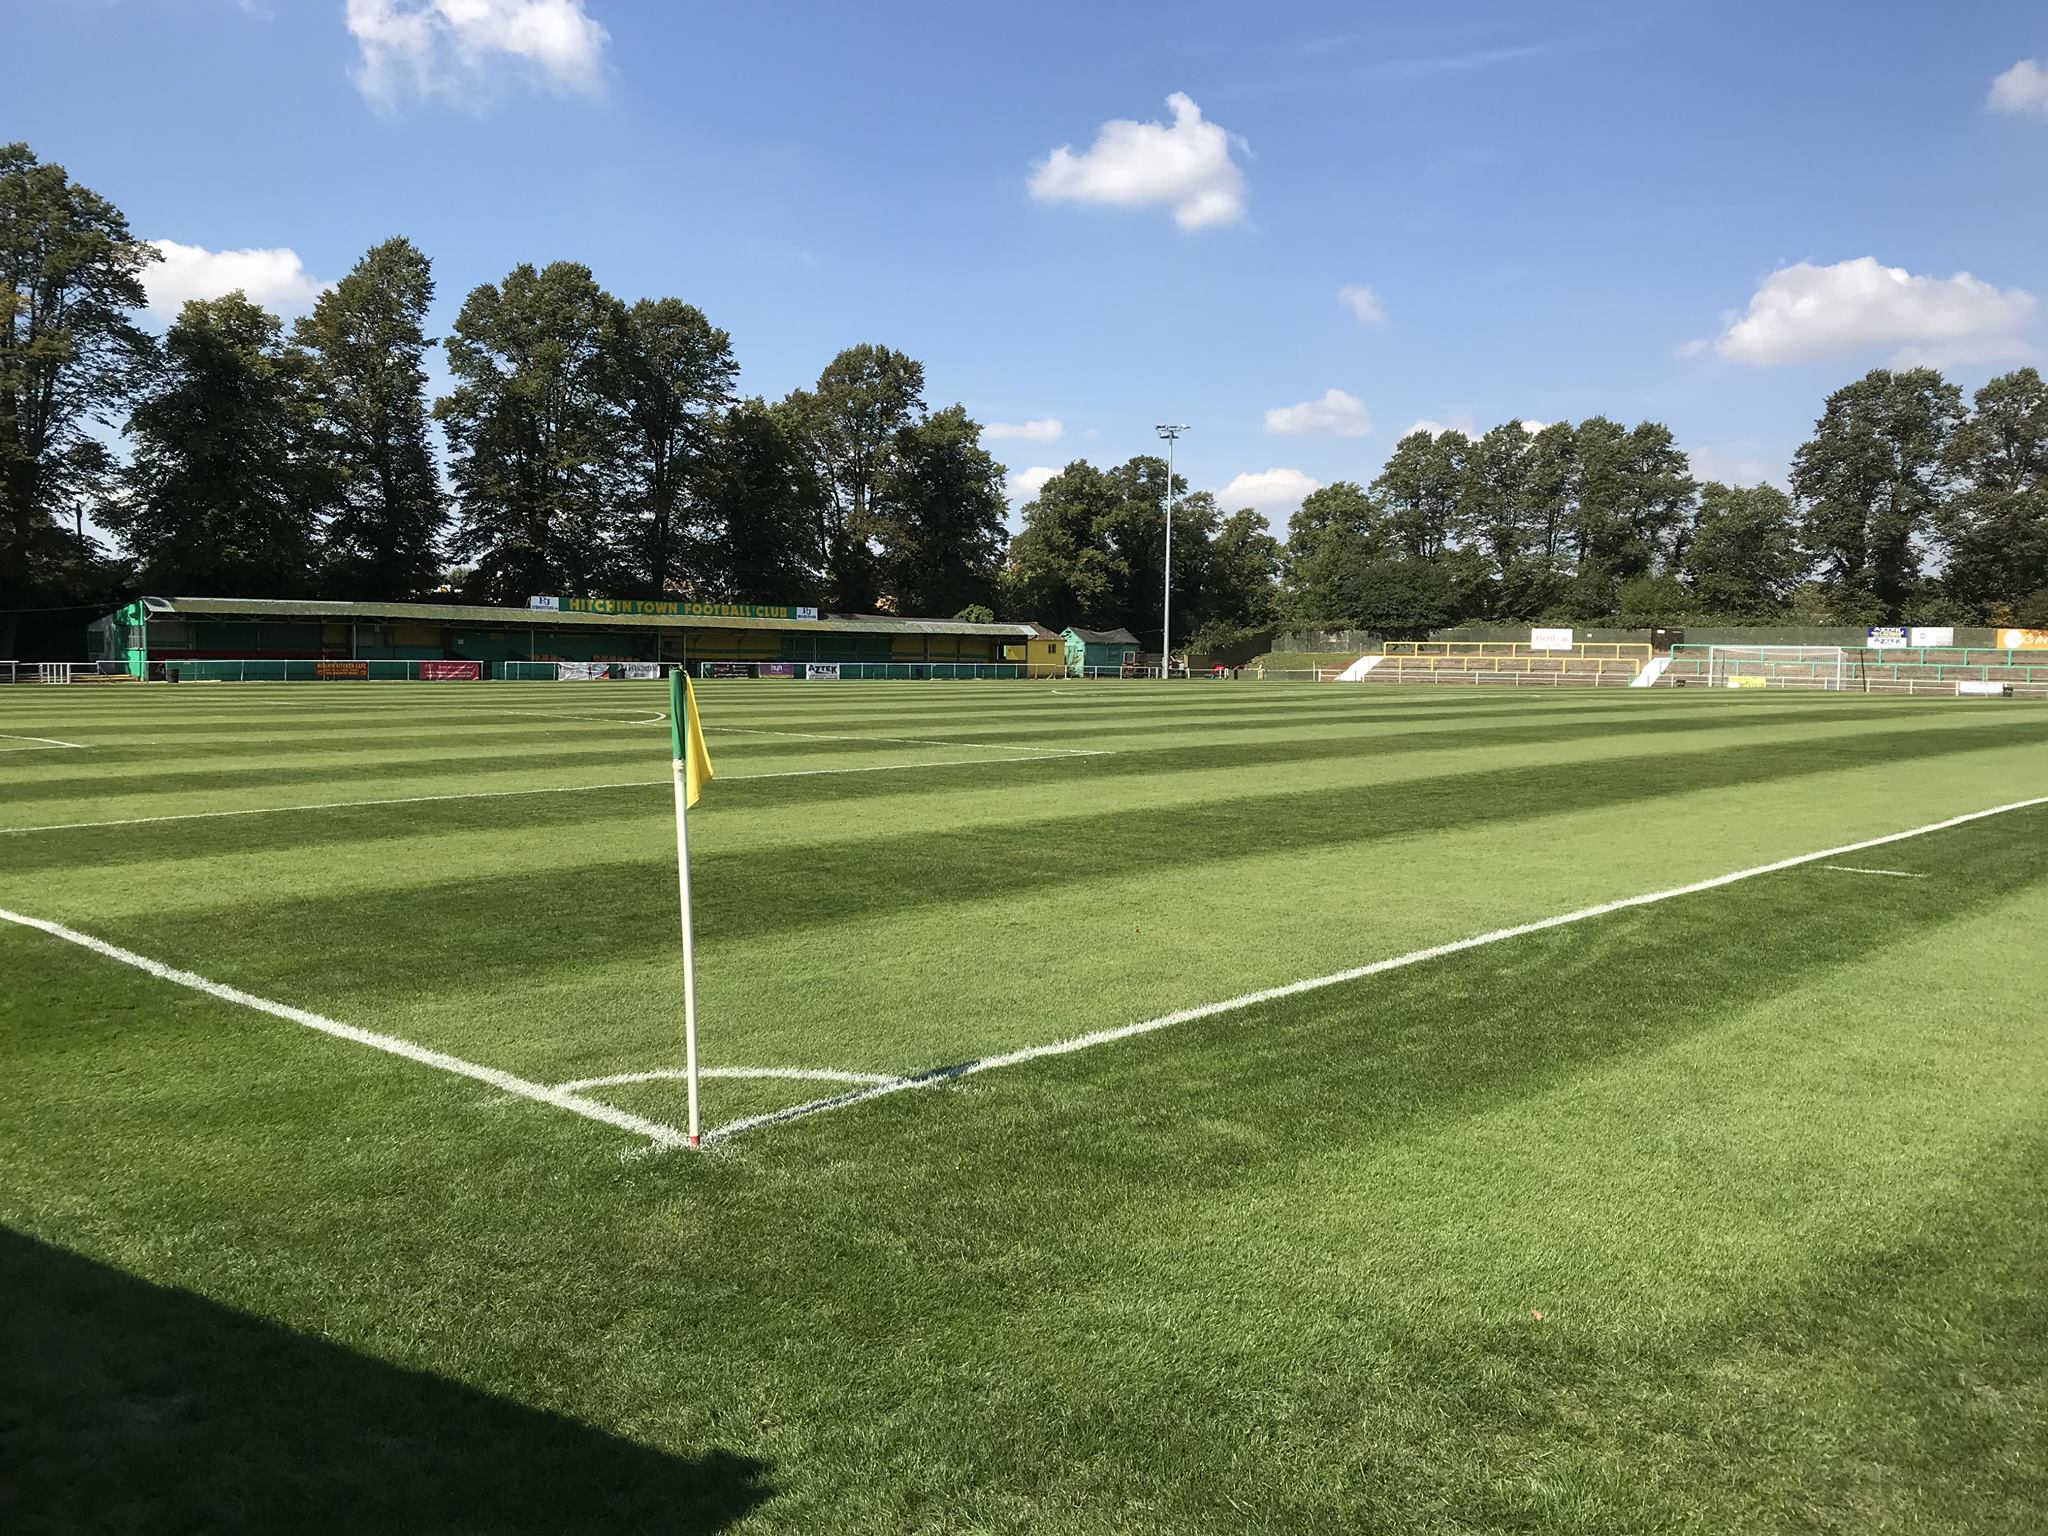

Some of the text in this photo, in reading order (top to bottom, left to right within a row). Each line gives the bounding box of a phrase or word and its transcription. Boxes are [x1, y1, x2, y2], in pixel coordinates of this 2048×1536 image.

[569, 598, 788, 618] HITCHIN TOWN FOOTBALL CLUB
[807, 664, 838, 674] AZTEK
